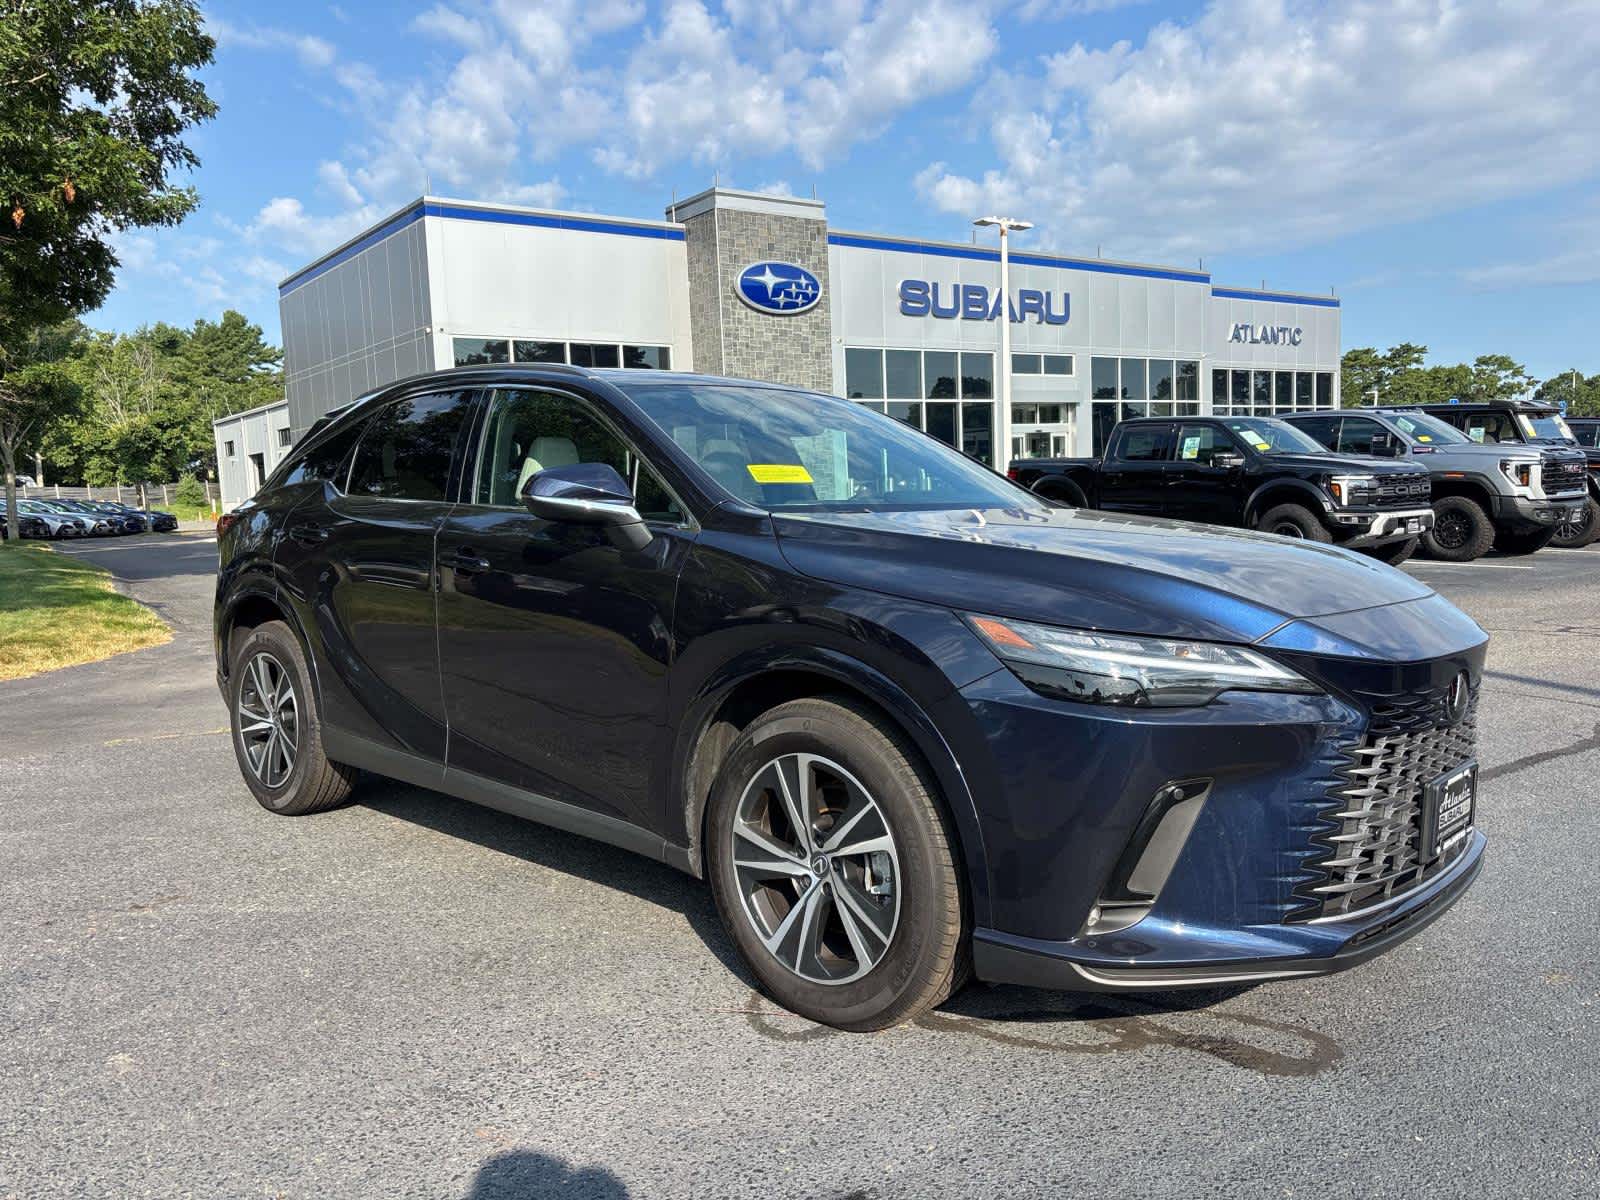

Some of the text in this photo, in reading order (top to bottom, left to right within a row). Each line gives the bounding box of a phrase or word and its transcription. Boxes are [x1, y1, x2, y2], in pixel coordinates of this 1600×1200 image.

[899, 279, 1070, 324] SUBARU
[1228, 323, 1303, 346] ATLANTIC
[1376, 484, 1432, 497] FORD
